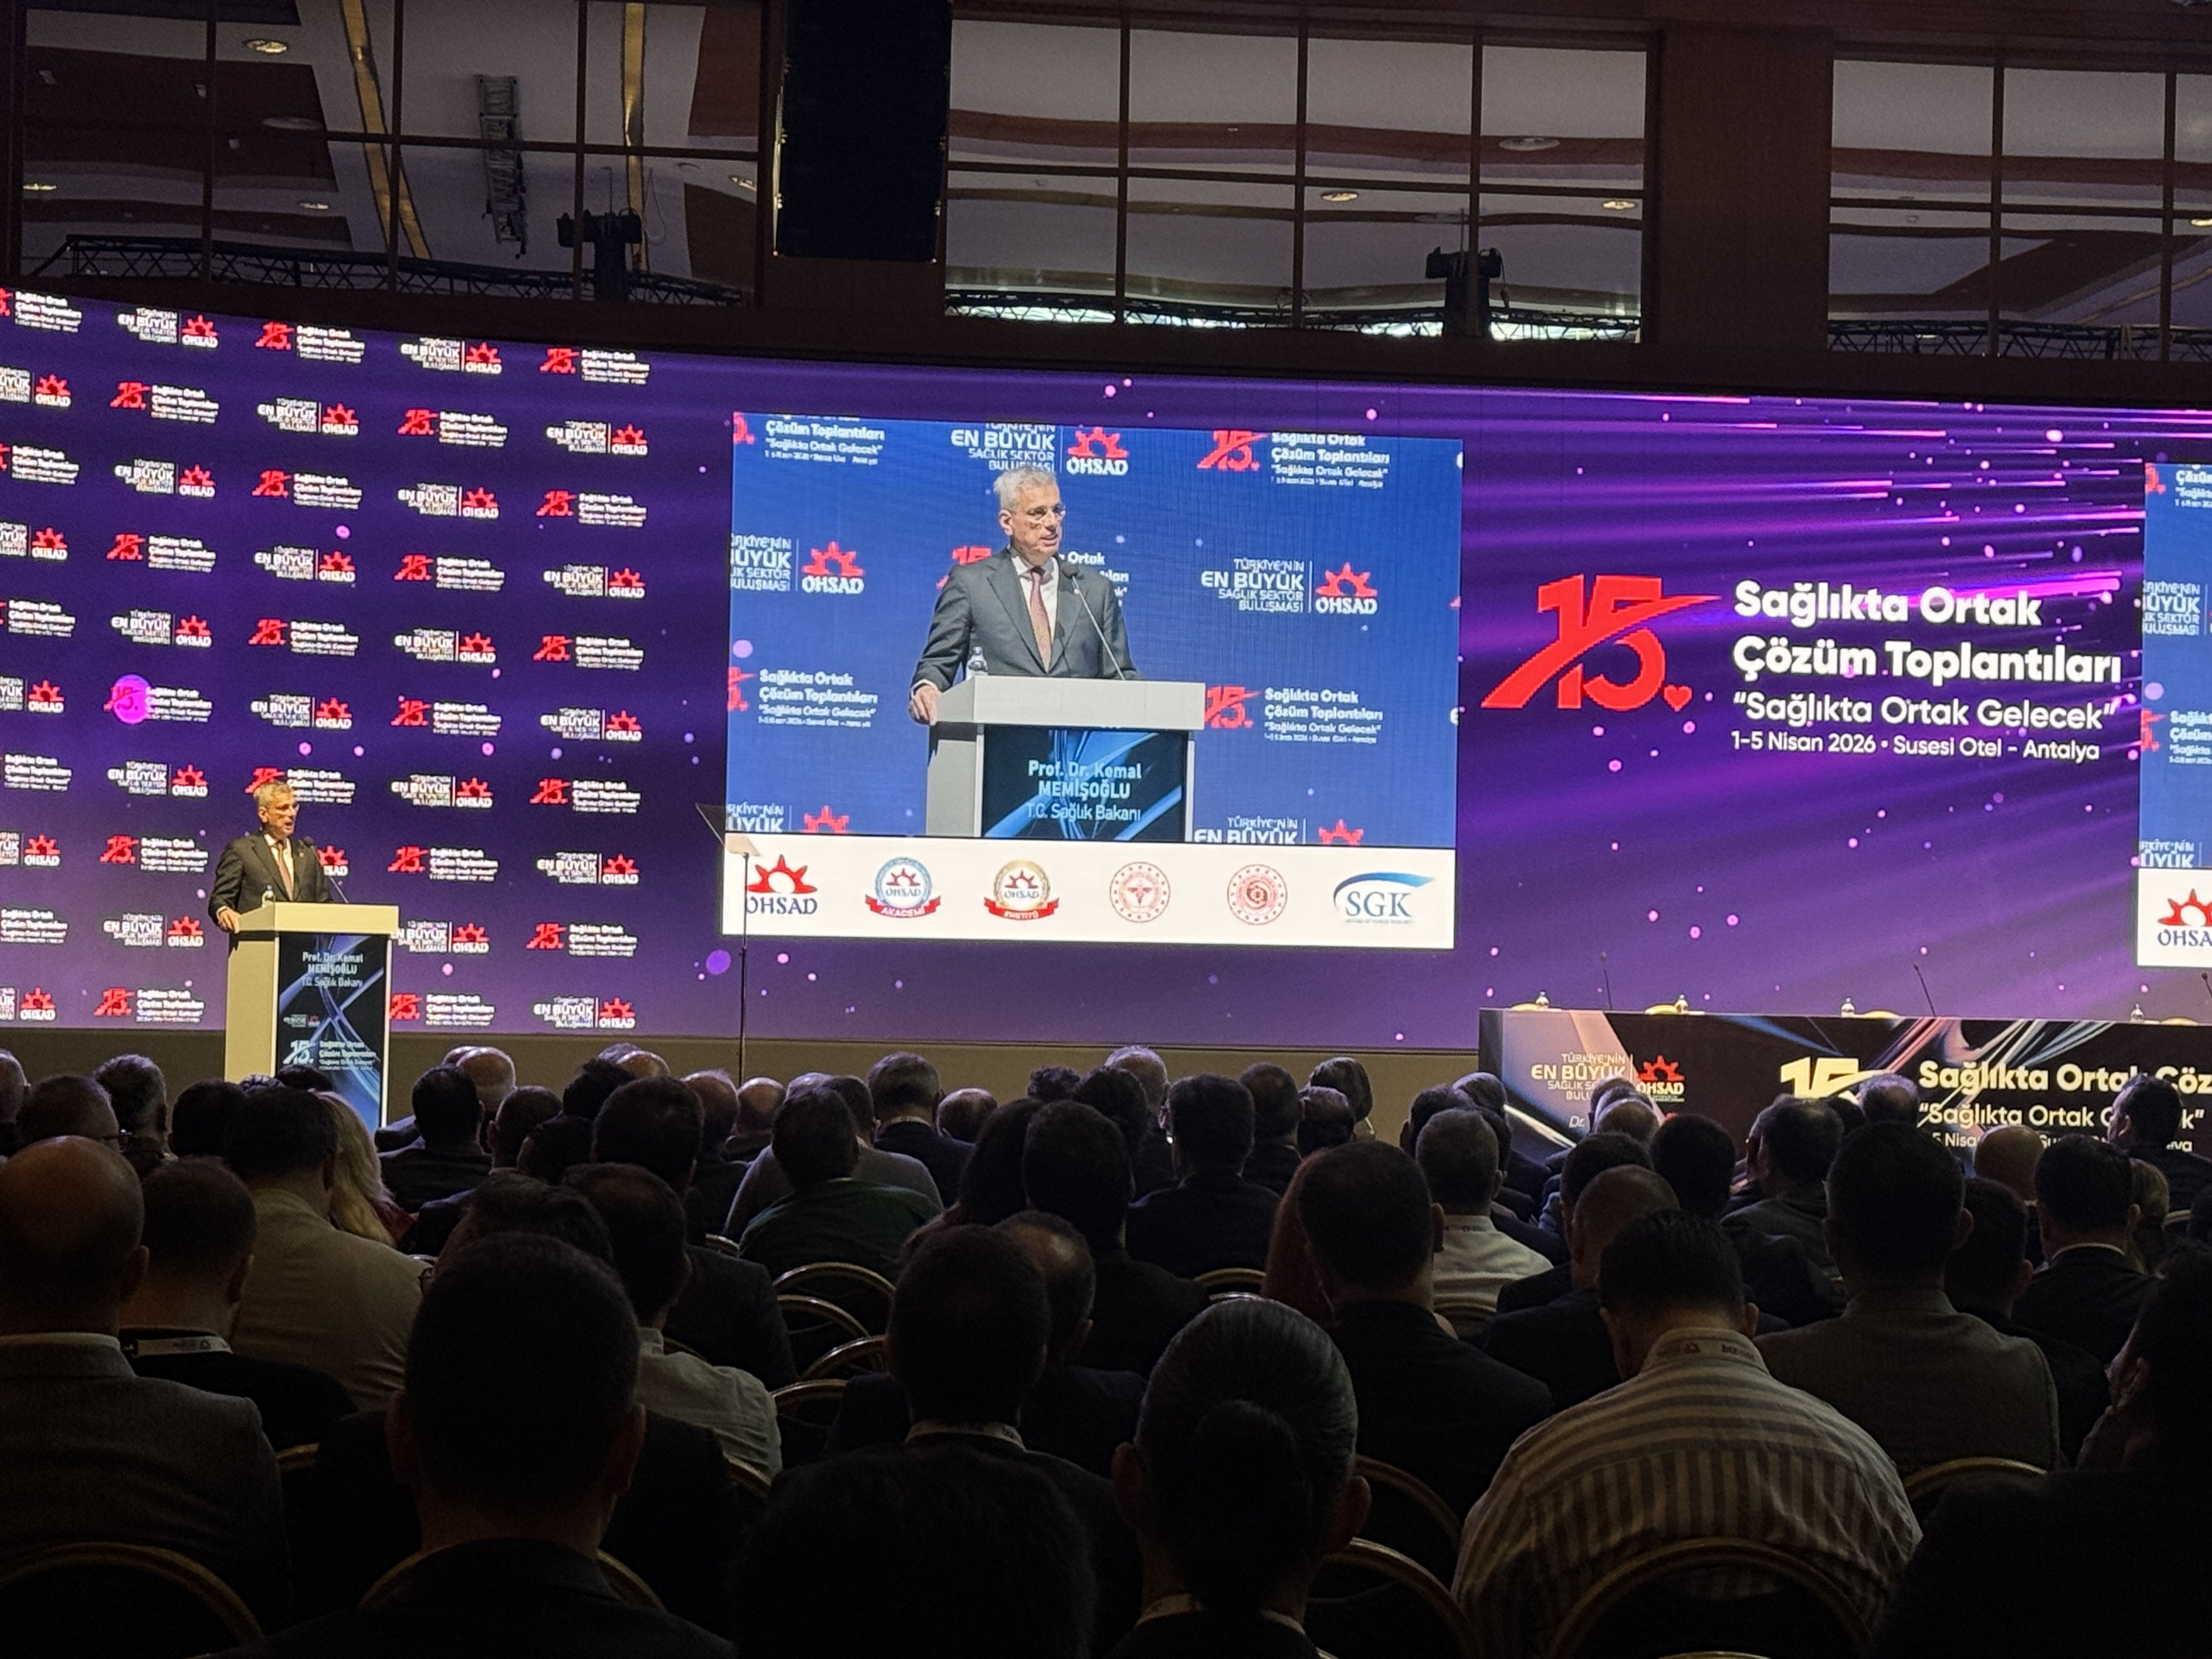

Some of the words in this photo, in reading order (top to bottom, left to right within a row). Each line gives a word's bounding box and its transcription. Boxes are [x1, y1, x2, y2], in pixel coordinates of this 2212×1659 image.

[951, 429, 979, 447] EN
[984, 430, 1055, 450] BÜYÜK
[1327, 434, 1366, 447] Ortak
[968, 448, 1007, 460] SAĞLIK
[1271, 447, 1316, 462] Çözüm
[1066, 456, 1128, 476] OHSAD
[731, 548, 792, 569] ÜYÜK
[1068, 551, 1105, 566] Ortak
[802, 575, 865, 594] OHSAD
[1201, 570, 1229, 588] EN
[1234, 571, 1305, 591] BÜYÜK
[1218, 589, 1257, 600] SAĞLIK
[1260, 589, 1304, 602] SEKTÖR
[1734, 580, 1909, 628] Sağlıkta
[1920, 586, 2042, 626] Ortak
[1315, 596, 1378, 614] OHSAD
[1734, 635, 1876, 681] Çözüm
[1885, 641, 2121, 687] Toplantıları
[759, 669, 814, 686] Sağlıkta
[815, 671, 854, 686] Ortak
[1264, 687, 1319, 704] Sağlıkta
[1321, 689, 1359, 704] Ortak
[1264, 704, 1308, 720] Çözüm
[1881, 697, 1969, 726] Ortak
[1731, 730, 1763, 749] 1-5
[1768, 731, 1822, 752] Nisan
[1829, 733, 1876, 753] 2026
[1894, 735, 1955, 756] Susesi
[1959, 737, 2002, 758] Otel
[2023, 741, 2100, 764] Antalya
[1028, 759, 1064, 777] Prof.
[1070, 761, 1090, 777] Dr.
[1094, 762, 1142, 779] Kemal
[1039, 777, 1131, 802] MEMİŞOĞLU
[1051, 802, 1093, 822] Sağlık
[1095, 804, 1141, 821] Bakanı
[885, 888, 921, 897] OHSAD
[1004, 890, 1039, 899] OHSAD
[747, 896, 818, 915] OHSAD
[1345, 891, 1412, 917] SGK
[1561, 1052, 1626, 1065] TÜRKİYE'NİN
[1532, 1065, 1556, 1080] EN
[1919, 1060, 2049, 1096] Sağlıkta
[1548, 1080, 1582, 1091] SAĞLIK
[1637, 1082, 1684, 1095] OHSAD
[2029, 1105, 2094, 1127] Ortak
[1945, 1132, 1979, 1147] Nisa
